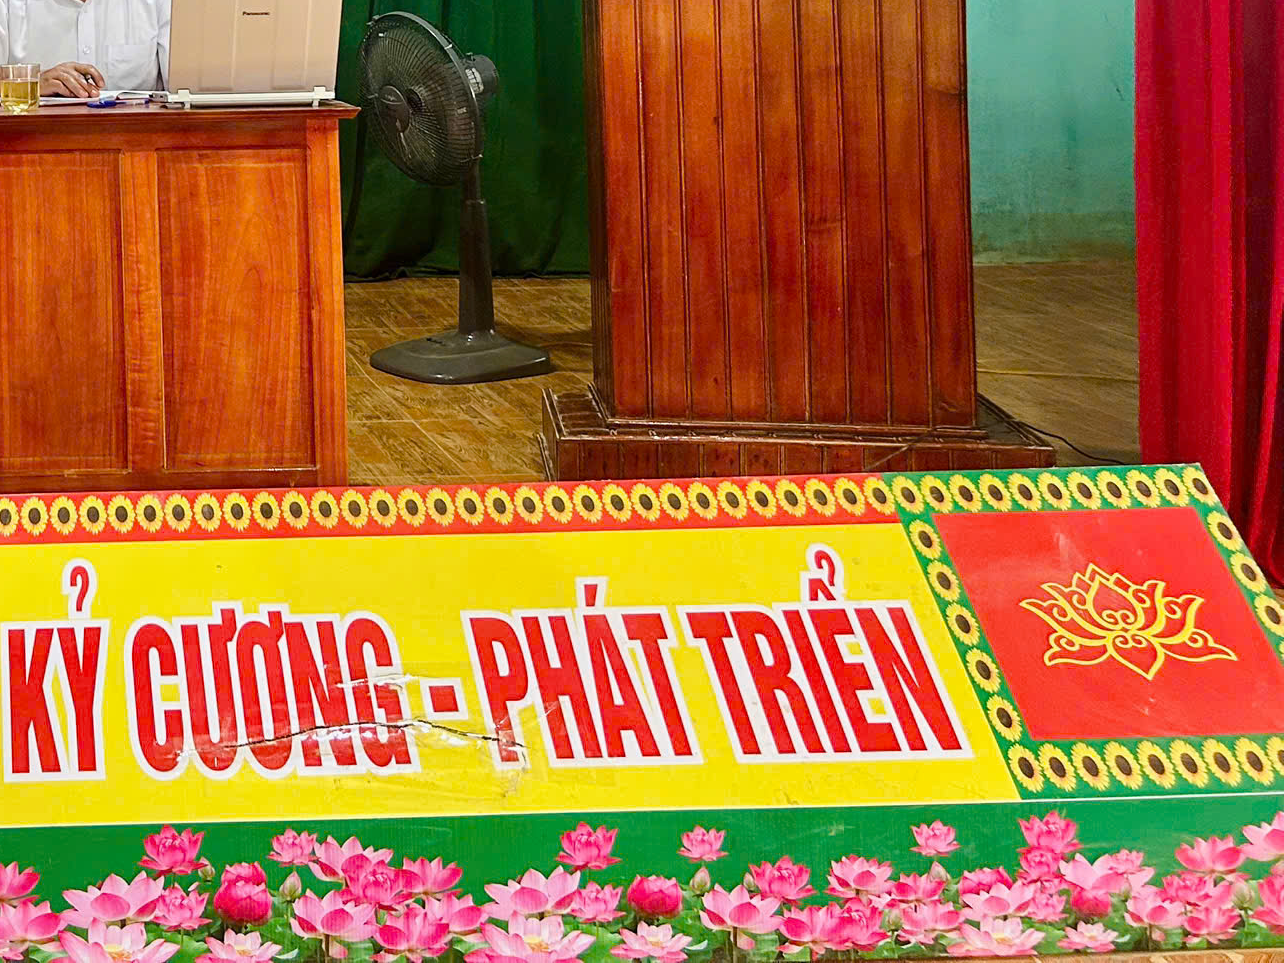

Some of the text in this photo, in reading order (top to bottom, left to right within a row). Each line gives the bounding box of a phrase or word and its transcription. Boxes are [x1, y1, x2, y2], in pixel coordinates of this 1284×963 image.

[6, 564, 105, 775] KỶ
[130, 606, 413, 773] CƯƠNG
[466, 582, 698, 763] PHÁT
[684, 548, 965, 758] TRIỂN
